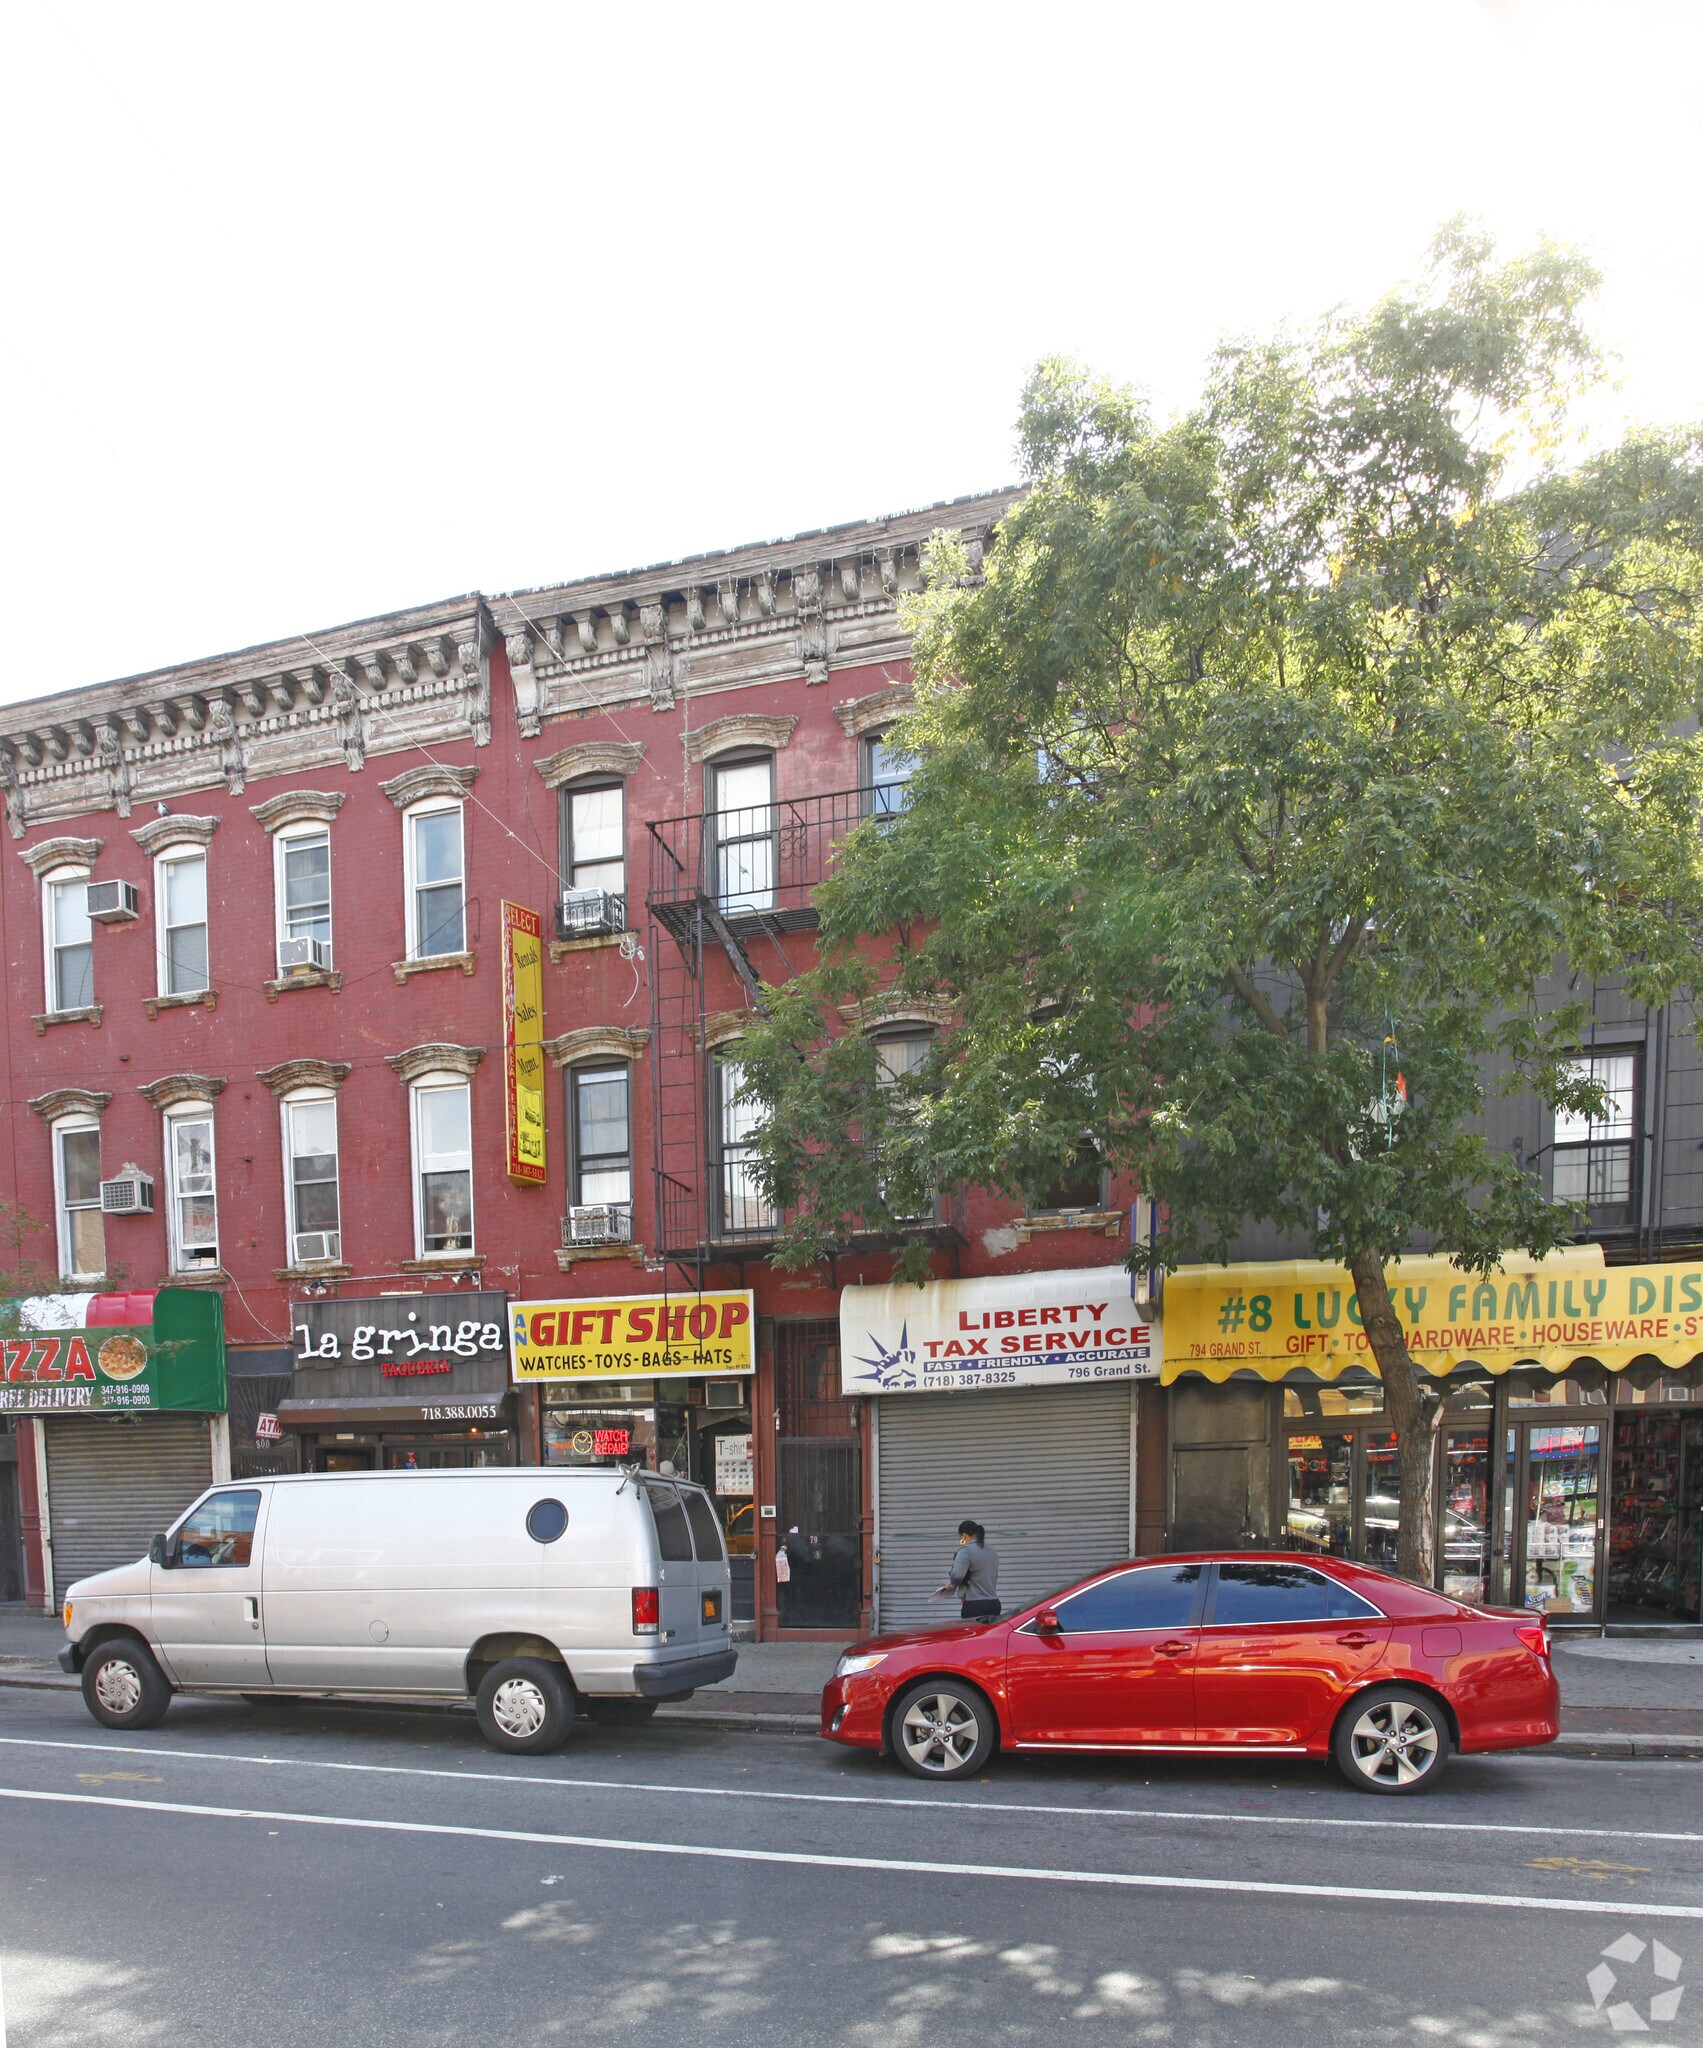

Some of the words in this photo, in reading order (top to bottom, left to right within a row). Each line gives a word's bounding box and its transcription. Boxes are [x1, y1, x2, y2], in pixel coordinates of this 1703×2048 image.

[504, 904, 537, 935] SELECT
[514, 946, 539, 969] Rentals
[515, 1002, 538, 1023] Sales
[1218, 1295, 1272, 1333] #8
[1294, 1285, 1427, 1329] LUCY
[1448, 1278, 1607, 1322] FAMILY
[1629, 1273, 1703, 1315] DIS
[530, 1308, 621, 1347] GIFT
[626, 1301, 749, 1343] SHOP
[958, 1303, 1109, 1331] LIBERTY
[295, 1324, 341, 1360] la
[351, 1312, 503, 1360] gringa
[923, 1338, 989, 1358] TAX
[1000, 1325, 1150, 1353] SERVICE
[1286, 1334, 1329, 1354] GIFT
[1343, 1332, 1370, 1351] TO
[1532, 1318, 1669, 1343] HOUSEWARE
[1190, 1343, 1207, 1357] 794
[1209, 1341, 1245, 1356] GRAND
[1248, 1341, 1262, 1355] ST.
[381, 1360, 451, 1377] TAQUERIA
[926, 1360, 962, 1371] FAST
[977, 1355, 1049, 1369] FRIENDLY
[1065, 1348, 1147, 1362] ACCURATE
[923, 1375, 955, 1388] (718)
[958, 1372, 1016, 1385] 387-8325
[1068, 1368, 1091, 1379] 796
[1094, 1364, 1132, 1377] Grand
[1134, 1363, 1151, 1375] St.
[28, 1386, 94, 1409] DELIVERY
[101, 1384, 150, 1395] 347-916-0909
[421, 1405, 497, 1420] 718.388.0055
[258, 1418, 282, 1434] ATM
[594, 1430, 629, 1442] WATCH
[256, 1439, 270, 1449] 800
[594, 1442, 629, 1455] REPAIR
[1537, 1434, 1584, 1453] OPEN
